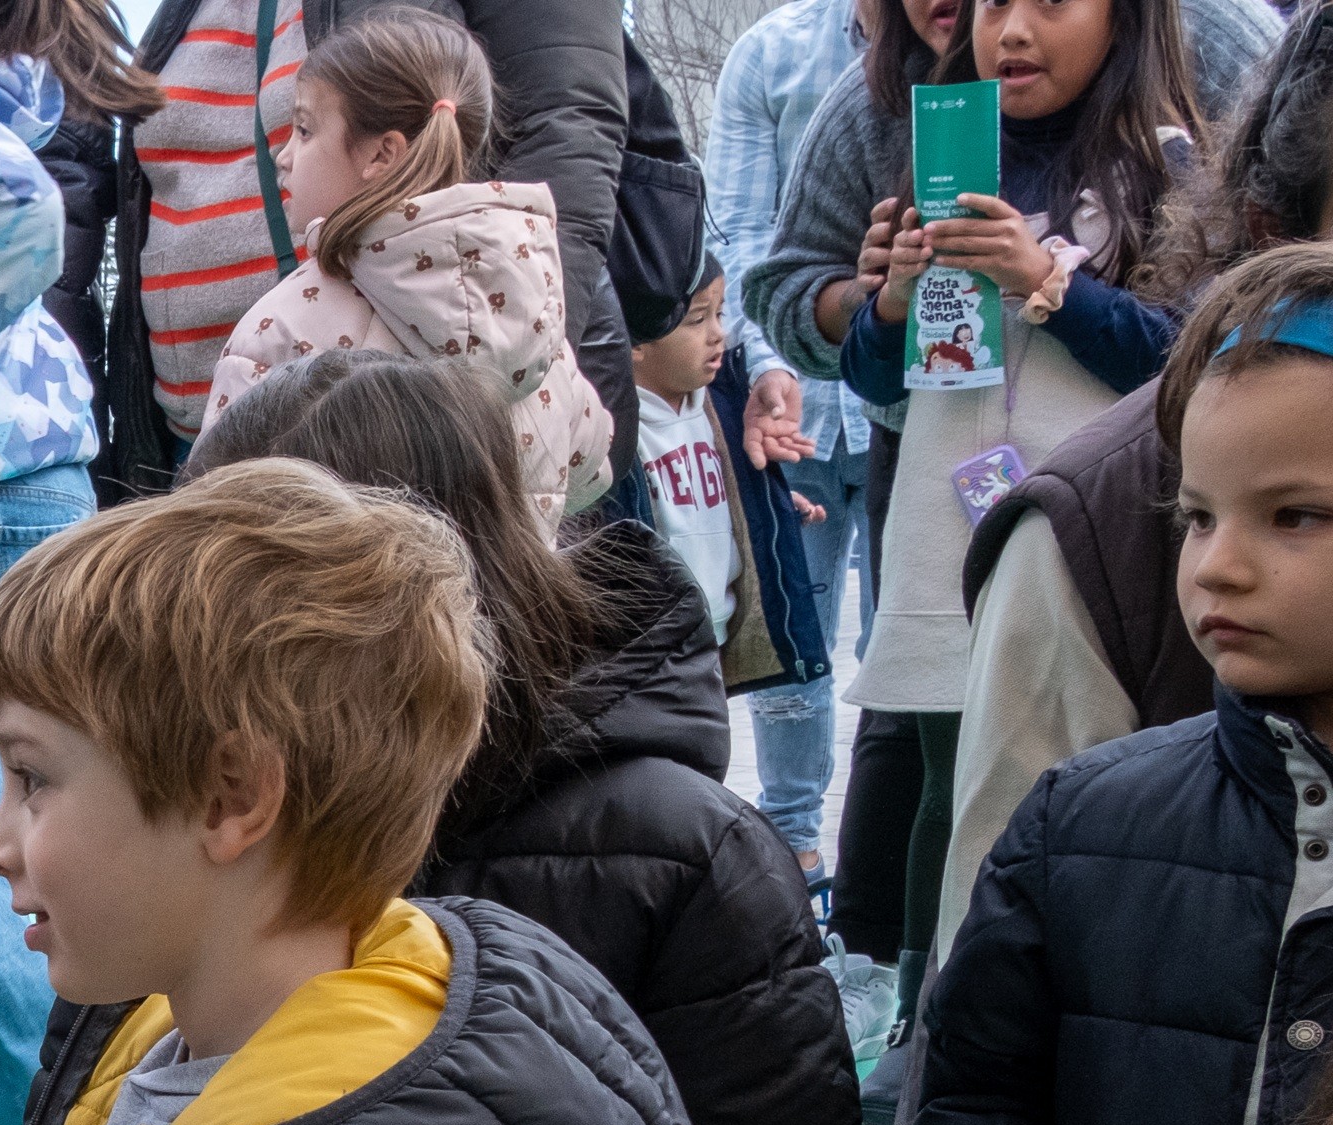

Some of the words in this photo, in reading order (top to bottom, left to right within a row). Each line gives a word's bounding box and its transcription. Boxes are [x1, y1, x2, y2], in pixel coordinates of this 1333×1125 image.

[927, 277, 959, 290] Festa
[921, 287, 955, 300] dona
[926, 299, 963, 311] nena
[921, 331, 952, 339] Tibidabo
